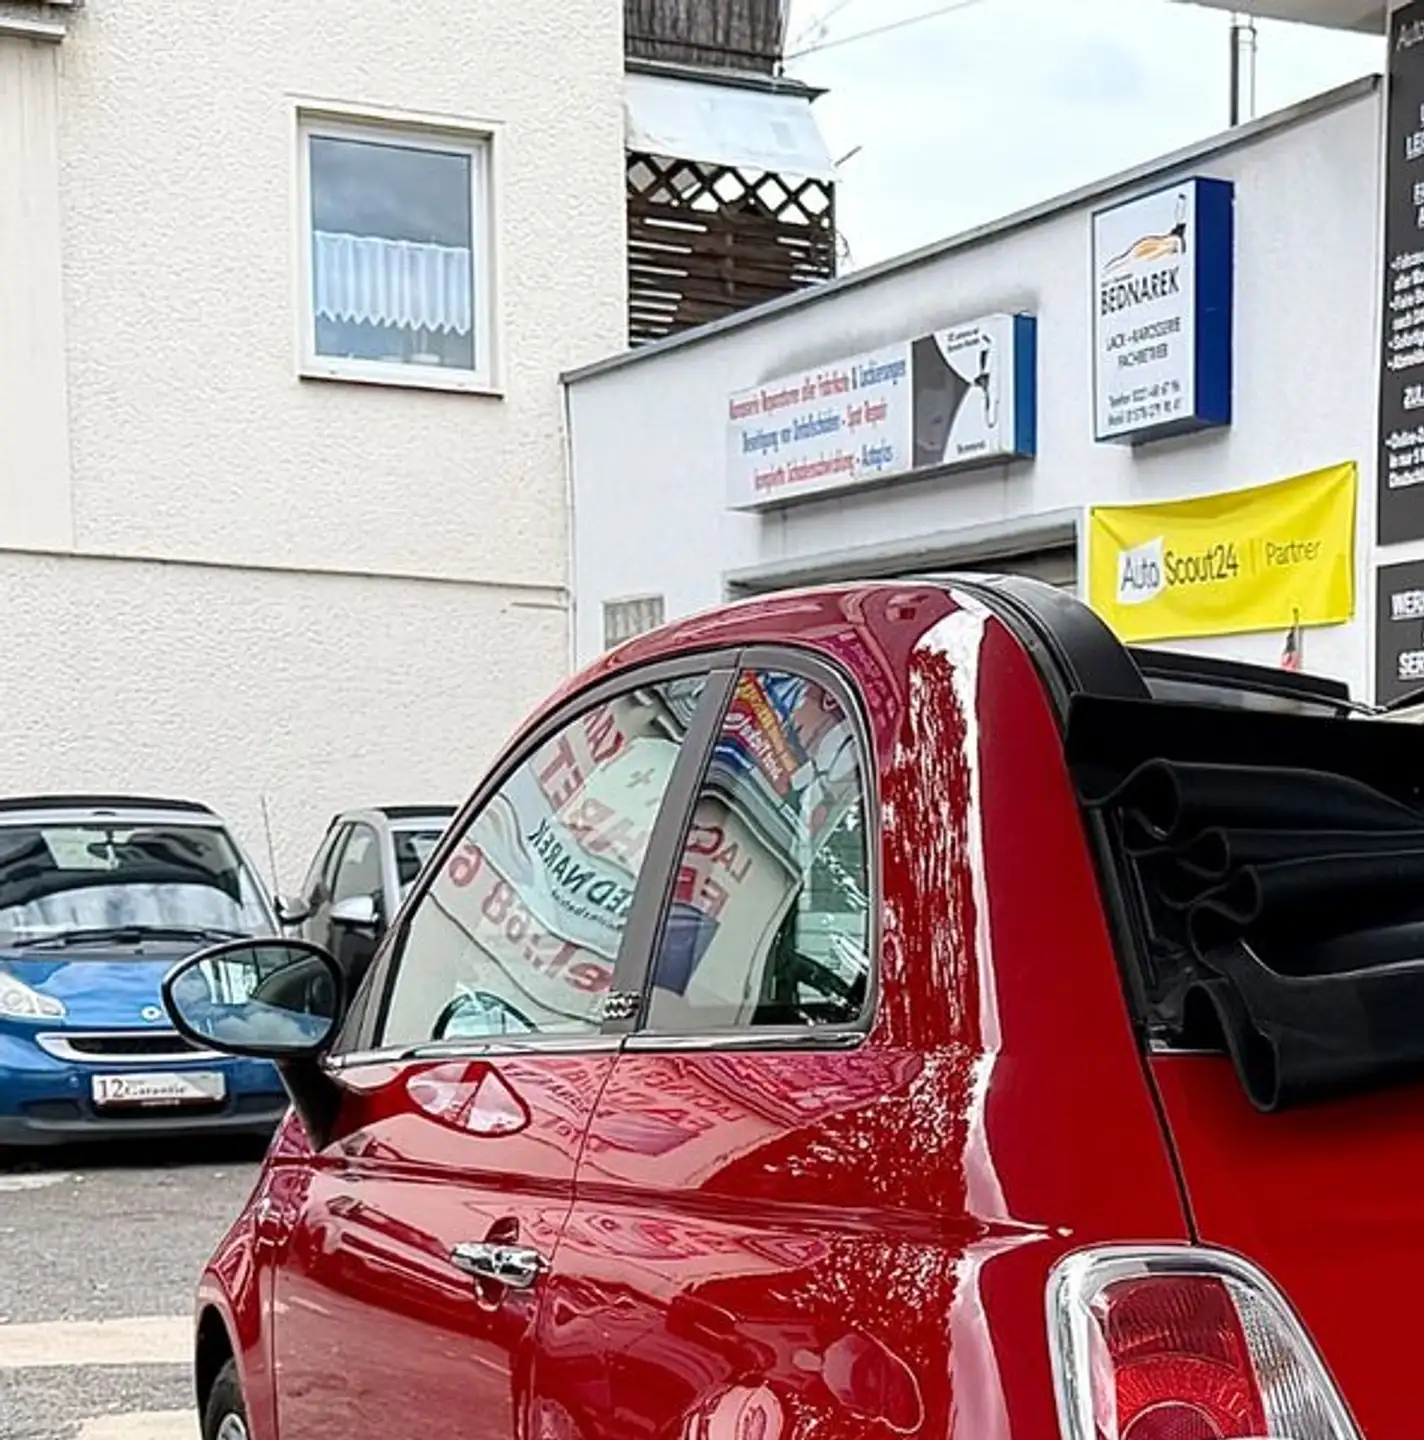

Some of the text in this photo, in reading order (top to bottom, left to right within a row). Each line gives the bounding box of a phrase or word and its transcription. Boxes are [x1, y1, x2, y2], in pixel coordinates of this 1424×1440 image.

[1100, 266, 1180, 316] BEDNAREK
[1265, 539, 1322, 566] Partner
[98, 1078, 125, 1099] 12
